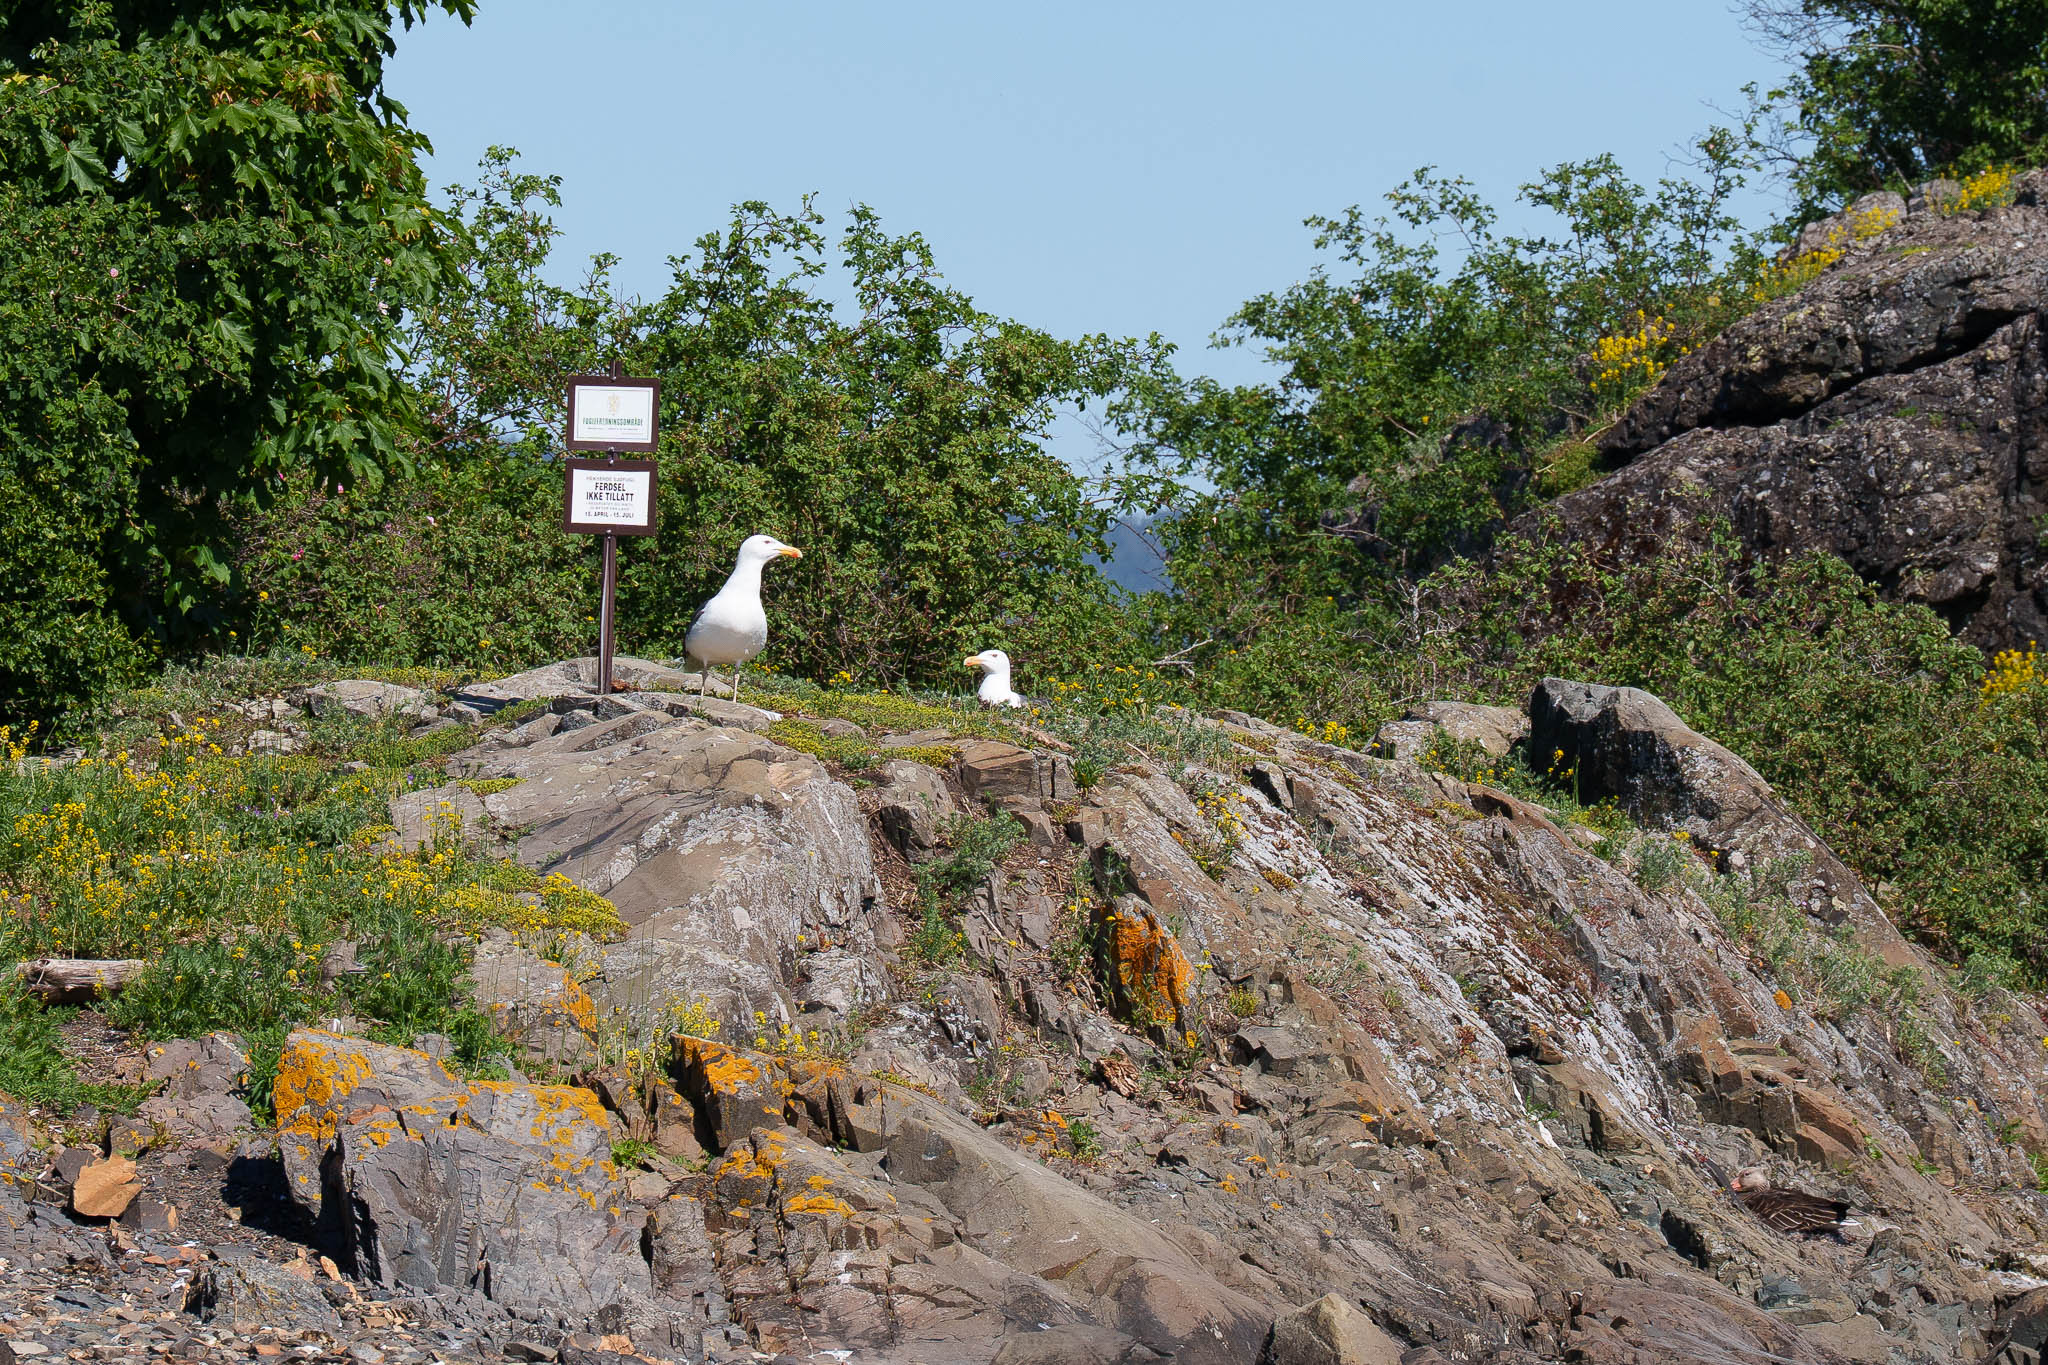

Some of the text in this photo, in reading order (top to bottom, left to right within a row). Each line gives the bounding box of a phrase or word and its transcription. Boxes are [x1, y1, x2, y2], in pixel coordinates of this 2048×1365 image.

[595, 482, 626, 492] FERDSEL
[586, 492, 634, 502] IKKE TILLATT
